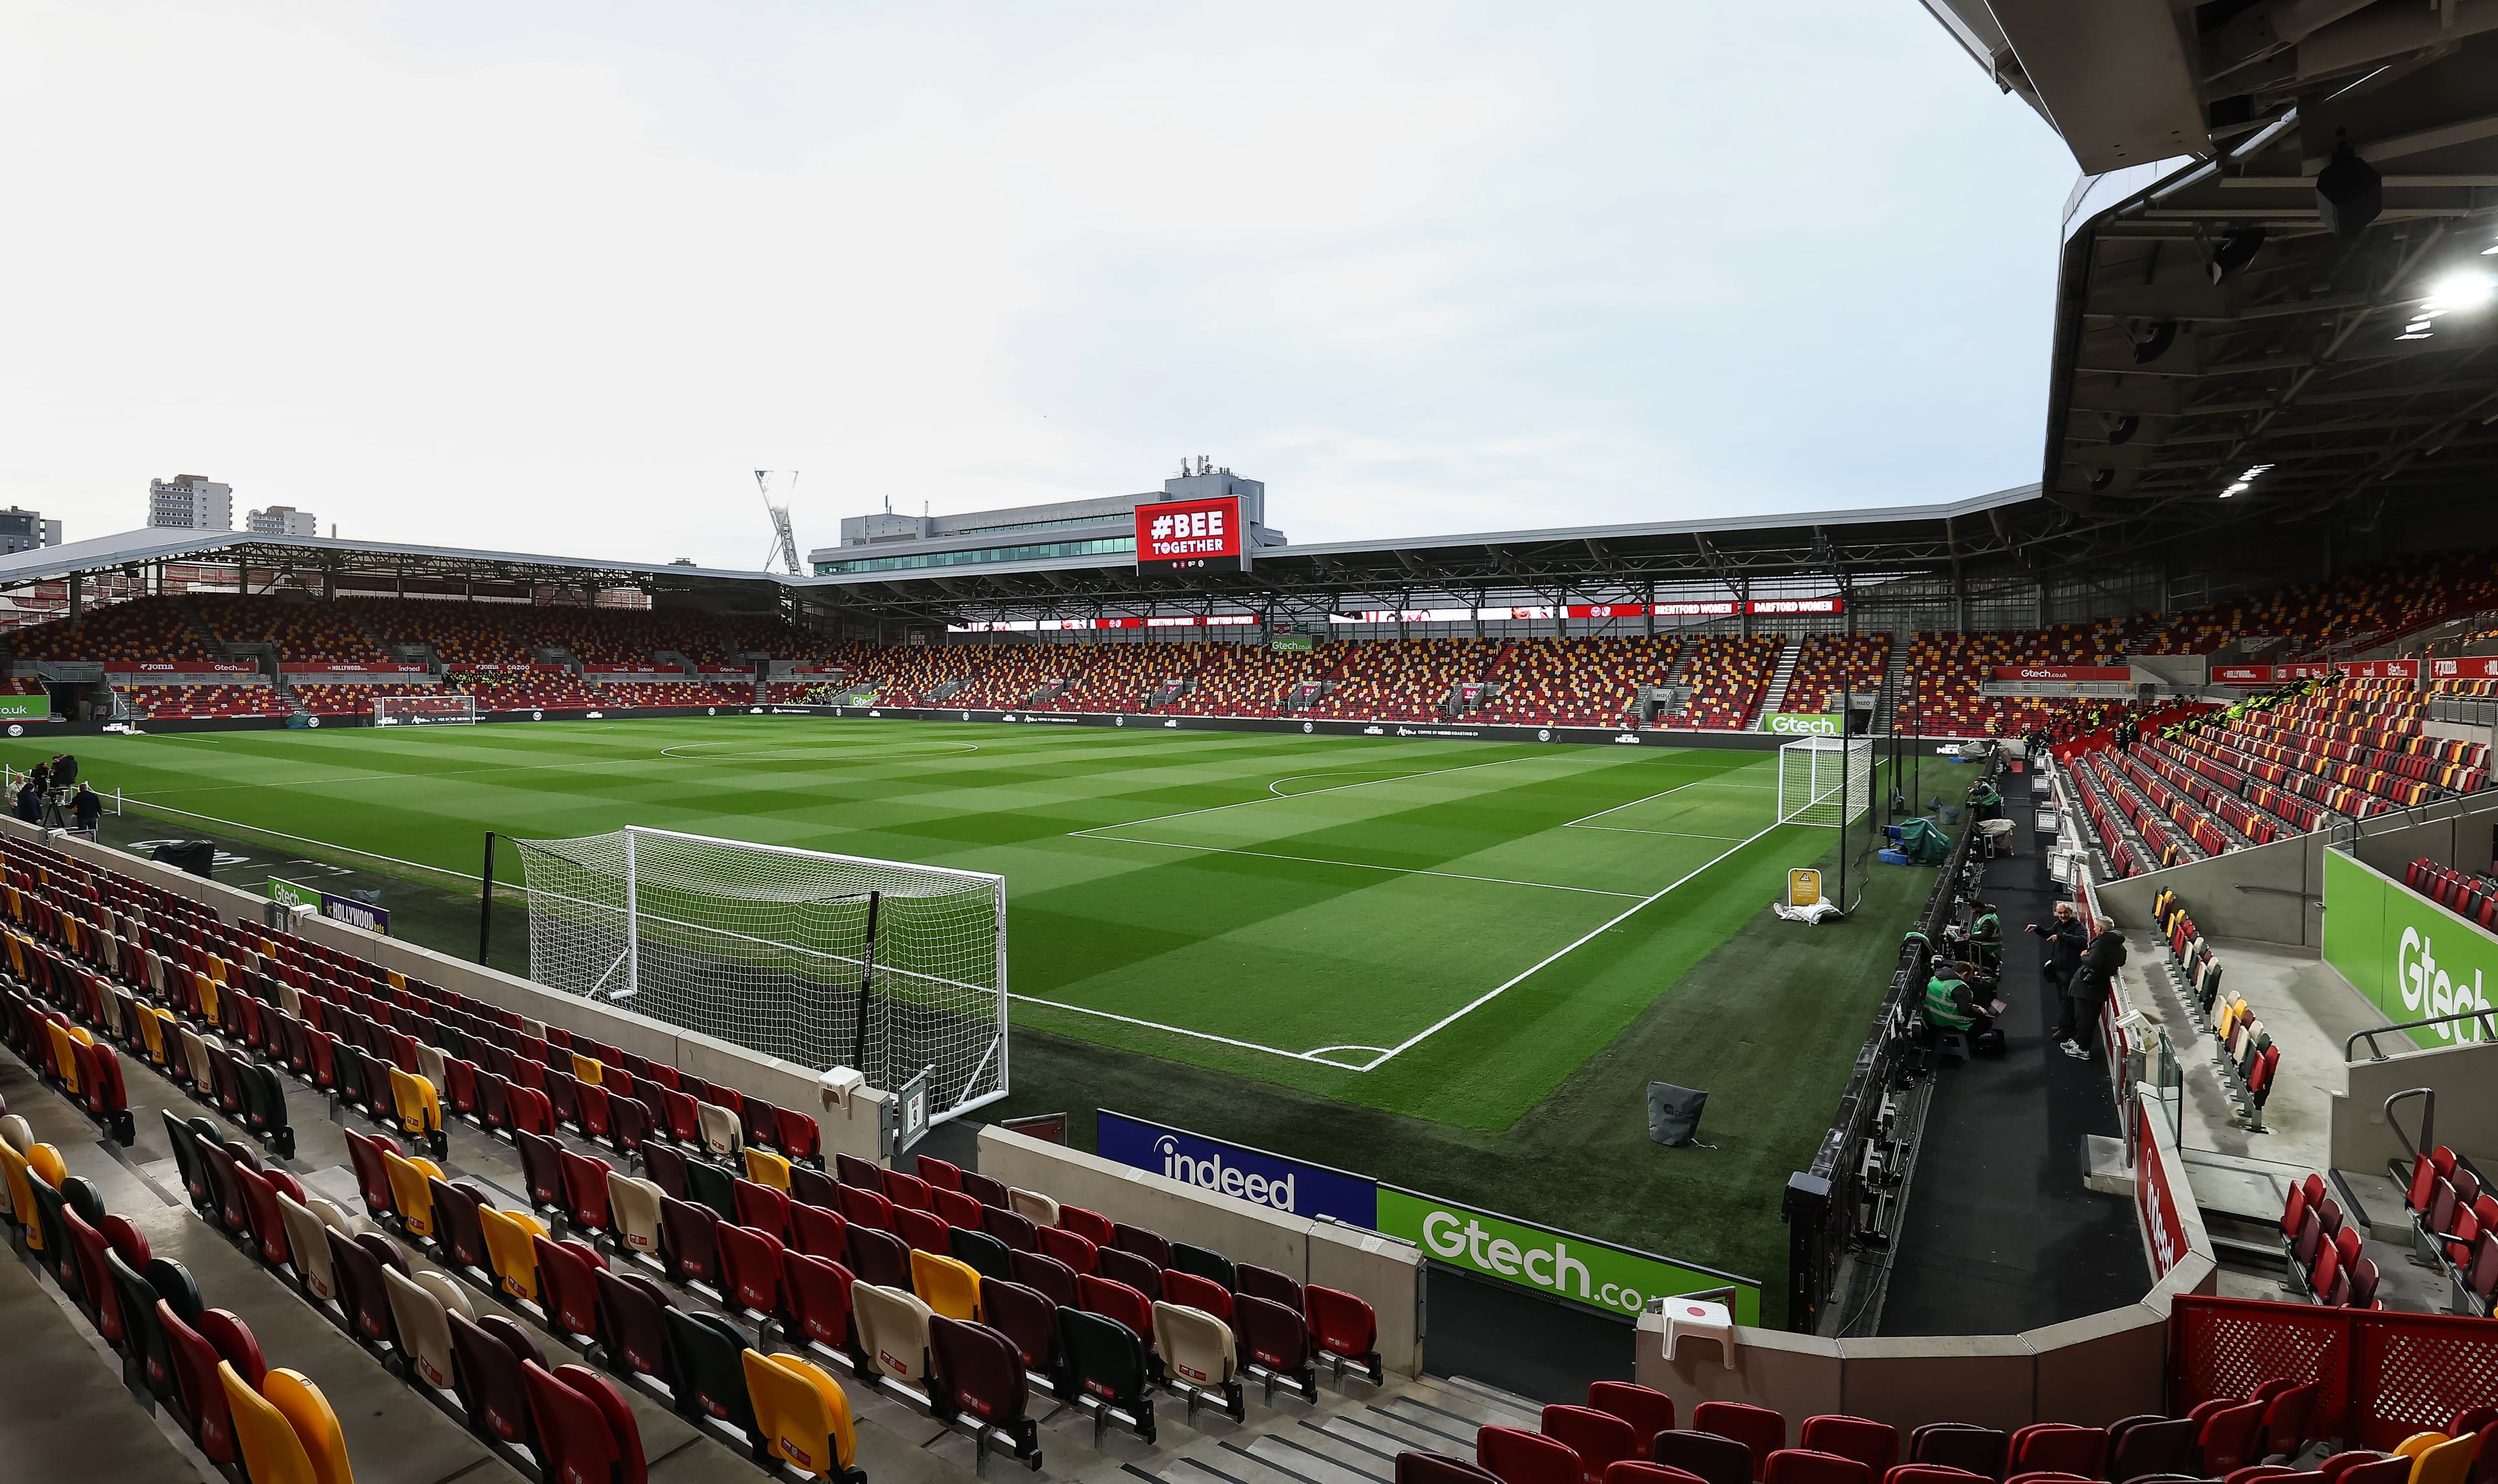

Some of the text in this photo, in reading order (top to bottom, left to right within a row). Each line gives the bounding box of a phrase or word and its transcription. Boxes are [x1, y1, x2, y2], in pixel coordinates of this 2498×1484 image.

[1151, 510, 1224, 540] #BEE
[1153, 539, 1224, 555] TOGETHER
[1655, 603, 1732, 615] BRENTFORD WOMEN
[1798, 601, 1833, 611] WOMEN
[1148, 617, 1194, 626] BRENTFORD WOMEN
[1272, 641, 1312, 650] Gtech.co.uk
[2021, 669, 2067, 678] Gtech.co.uk
[0, 706, 27, 715] o.uk
[1772, 716, 1834, 734] Gtech
[332, 901, 385, 934] HOLLYWOODbets
[2398, 926, 2496, 1045] Gtech
[913, 1109, 917, 1127] 9
[1153, 1135, 1295, 1213] indeed
[2146, 1147, 2174, 1277] indeed
[1423, 1210, 1645, 1312] Gtech.co
